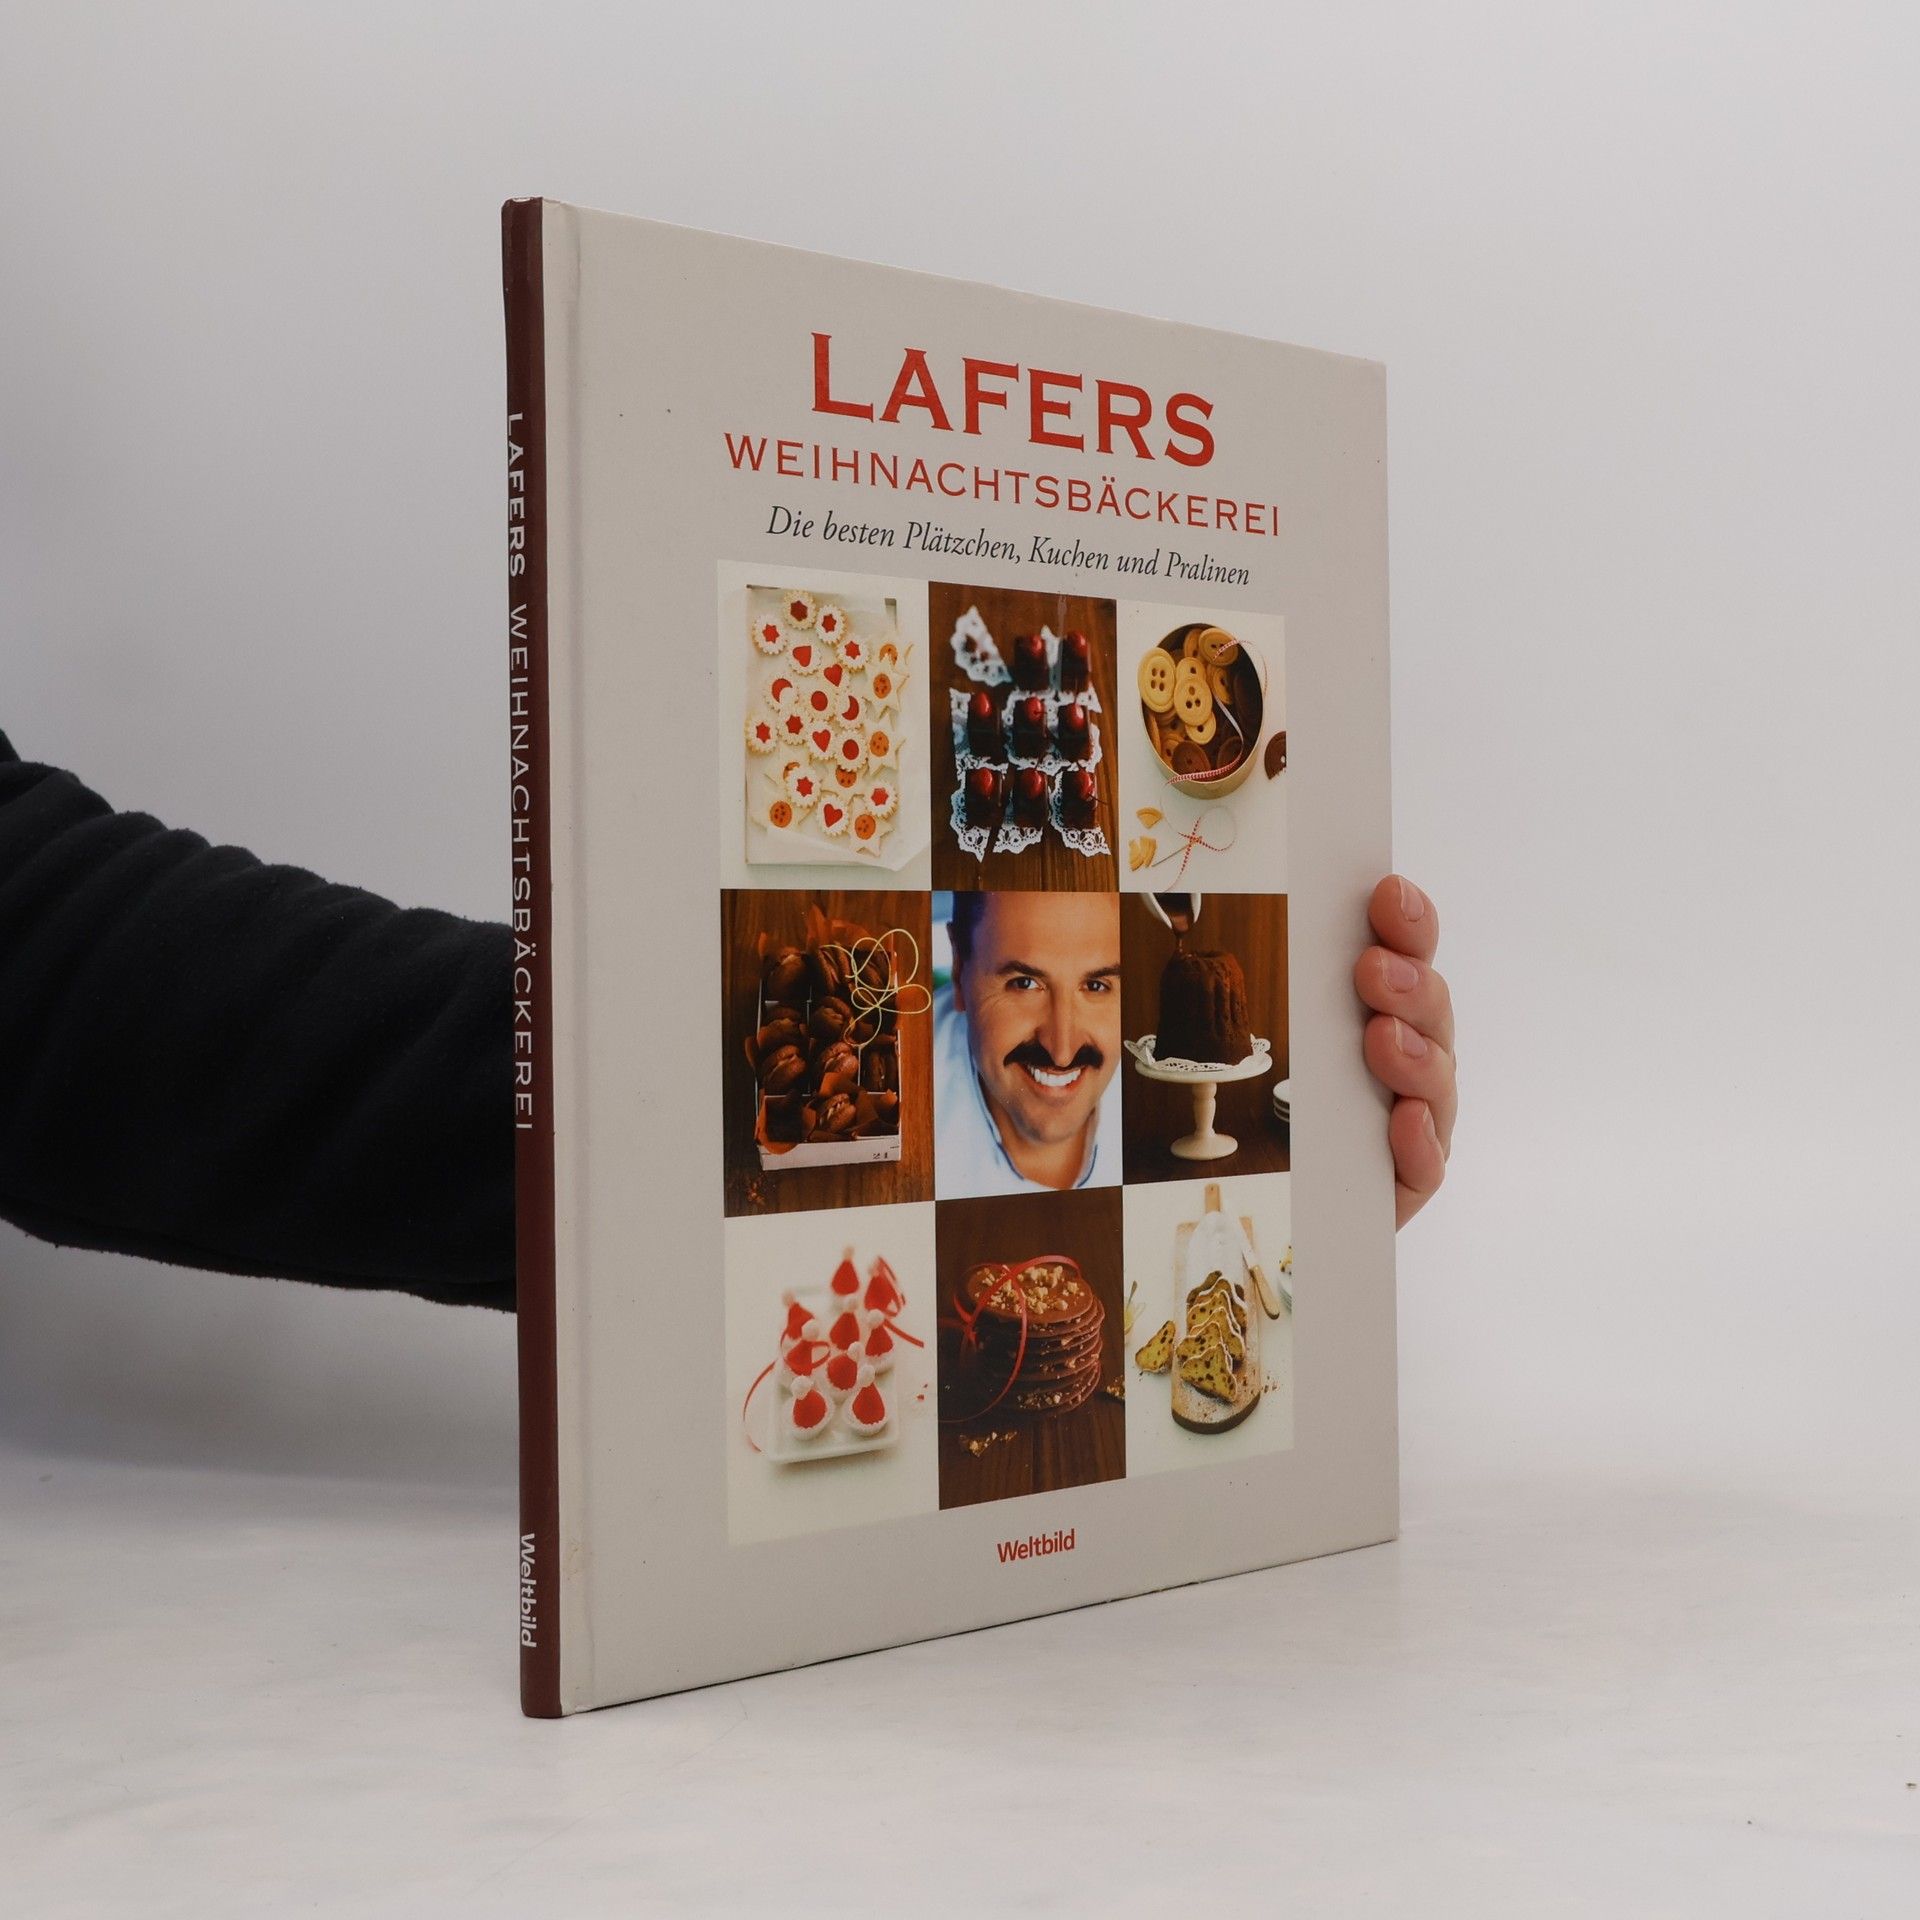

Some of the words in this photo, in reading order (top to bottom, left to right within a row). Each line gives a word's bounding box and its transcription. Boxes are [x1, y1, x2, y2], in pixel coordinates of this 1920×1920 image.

[811, 333, 1215, 467] LAFERS
[508, 412, 525, 577] LAFERS
[724, 432, 1279, 536] WEIHNACHTSBÄCKEREI
[766, 506, 814, 538] Die
[823, 510, 895, 547] besten
[903, 521, 1021, 563] Plätzchen,
[1028, 536, 1109, 570] Kuchen
[1117, 549, 1160, 575] und
[1165, 551, 1250, 586] Pralinen
[510, 603, 537, 1129] WEIHNACHTSBÄCKEREI
[521, 1533, 537, 1648] Weltbild
[997, 1528, 1075, 1563] Weltbild
